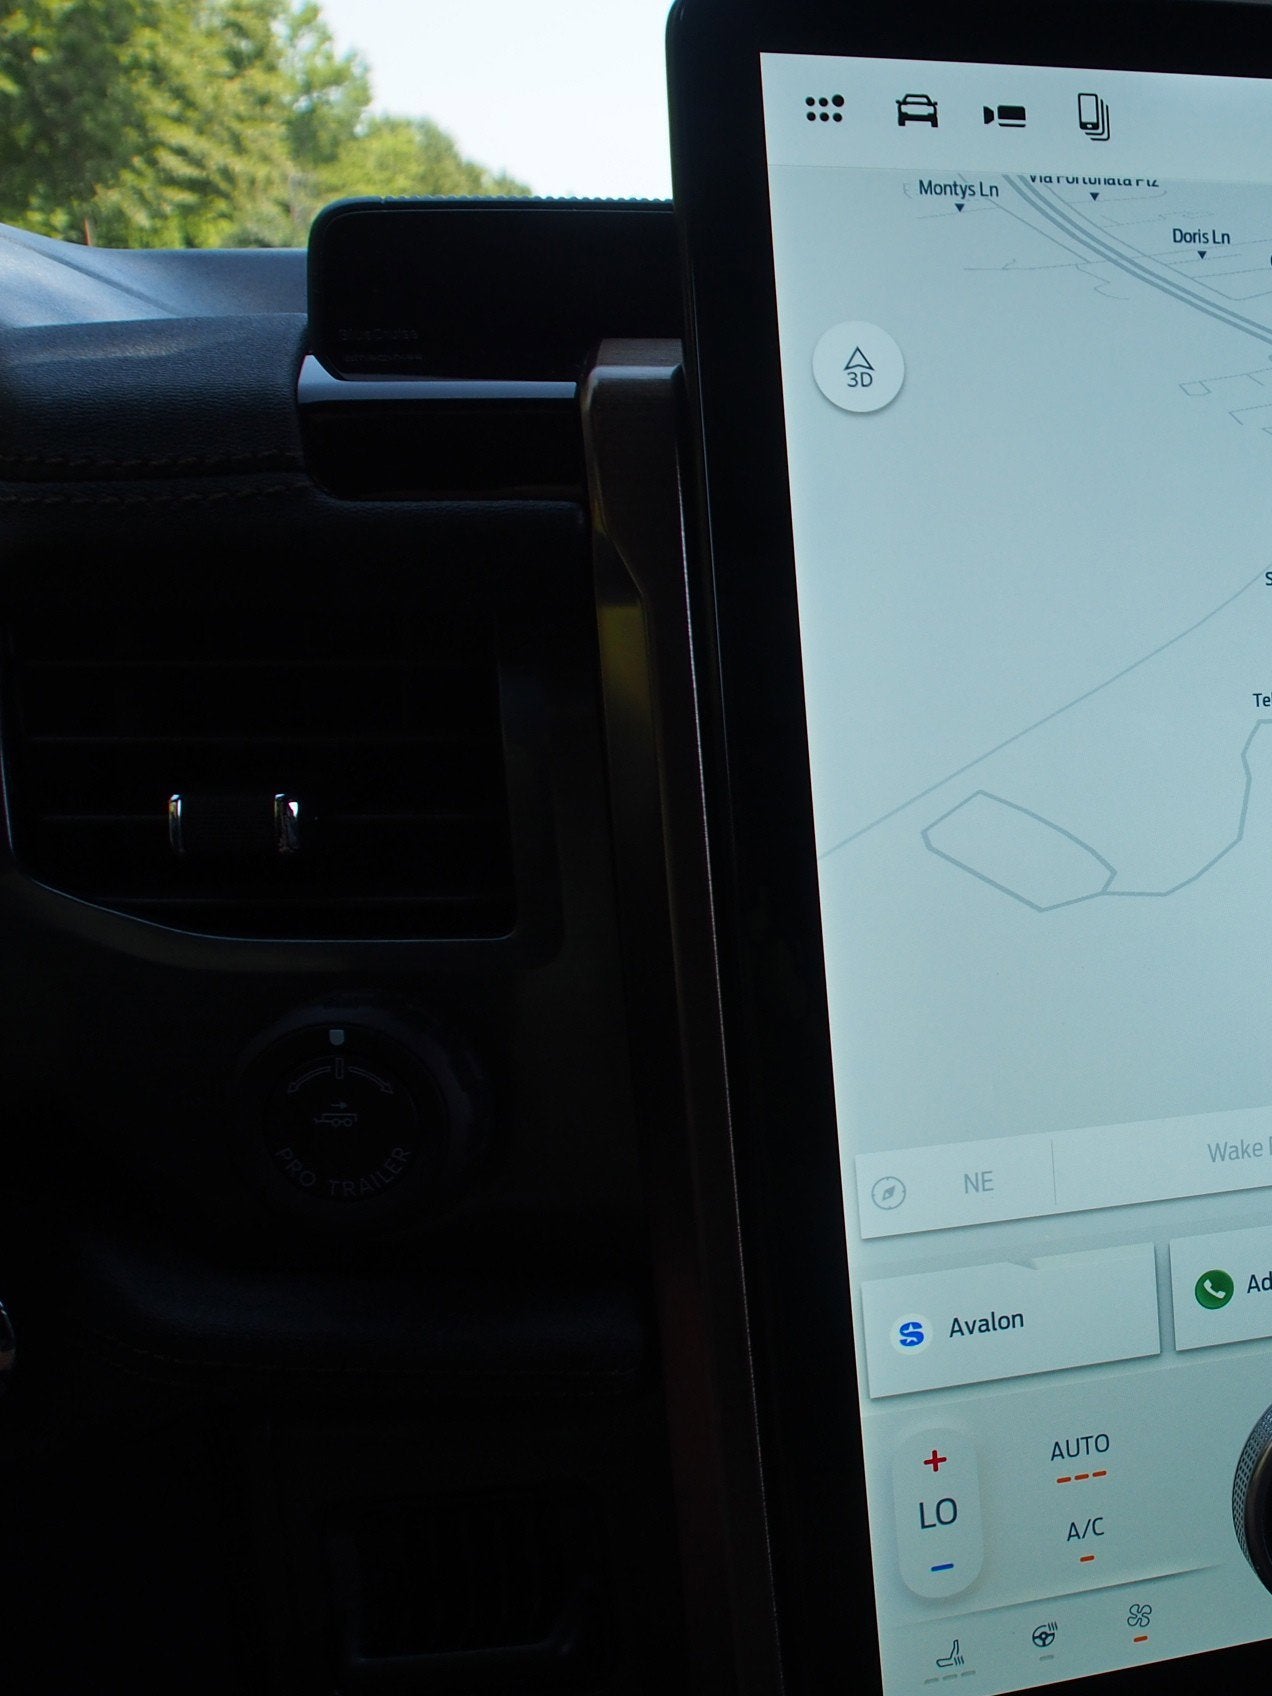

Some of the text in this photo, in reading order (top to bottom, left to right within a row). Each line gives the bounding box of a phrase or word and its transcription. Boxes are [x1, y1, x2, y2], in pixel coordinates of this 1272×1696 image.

[918, 179, 999, 199] Montys Ln
[1172, 228, 1231, 245] Doris Ln
[846, 370, 874, 388] 3D
[1207, 1141, 1264, 1163] Wake
[274, 1146, 412, 1198] PRO TRAILER
[963, 1170, 994, 1195] NE
[949, 1311, 1025, 1339] Avalon
[1050, 1433, 1111, 1461] AUTO
[919, 1498, 958, 1529] LO
[1066, 1517, 1105, 1542] A/C
